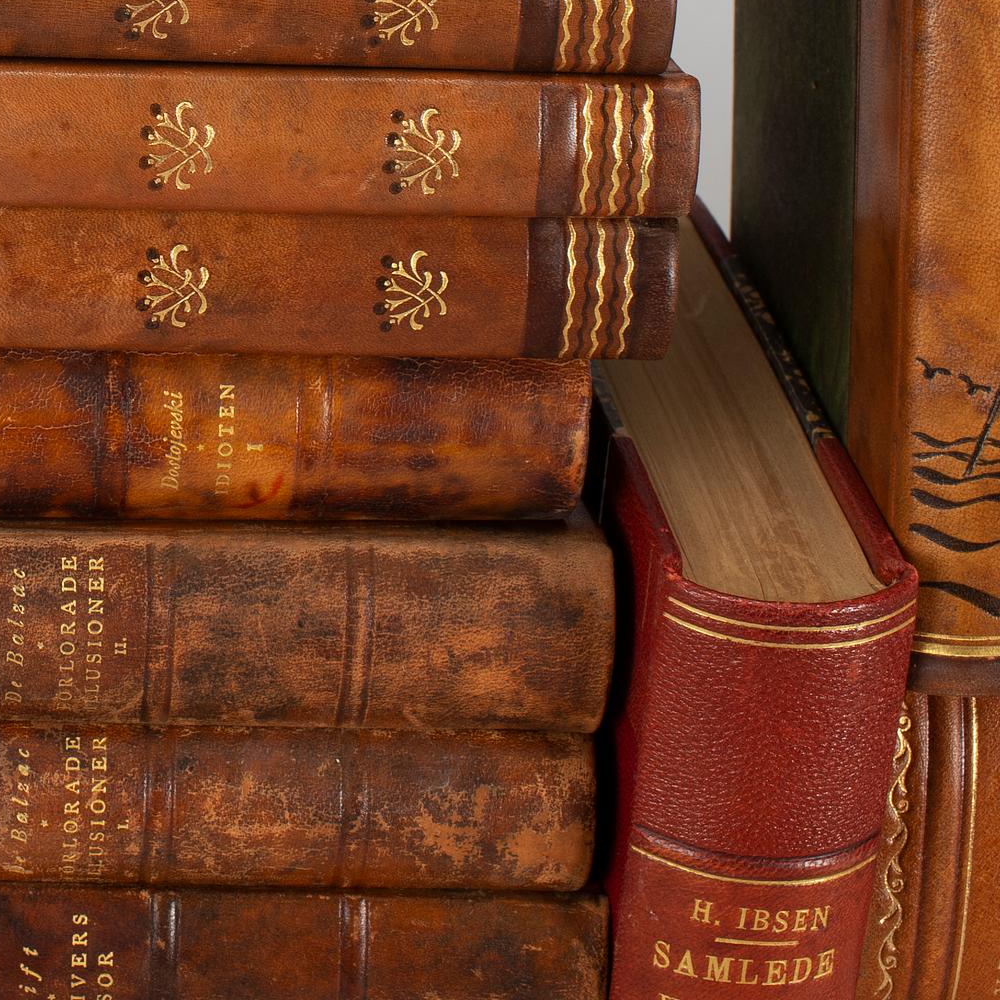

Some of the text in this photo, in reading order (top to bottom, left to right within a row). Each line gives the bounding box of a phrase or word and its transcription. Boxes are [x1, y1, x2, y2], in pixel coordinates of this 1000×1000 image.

[160, 390, 188, 491] Dostojevski
[214, 384, 236, 495] IDIOTEN
[6, 568, 26, 667] Balzac
[652, 939, 836, 986] SAMLEDE
[690, 898, 832, 934] H. IBSEN
